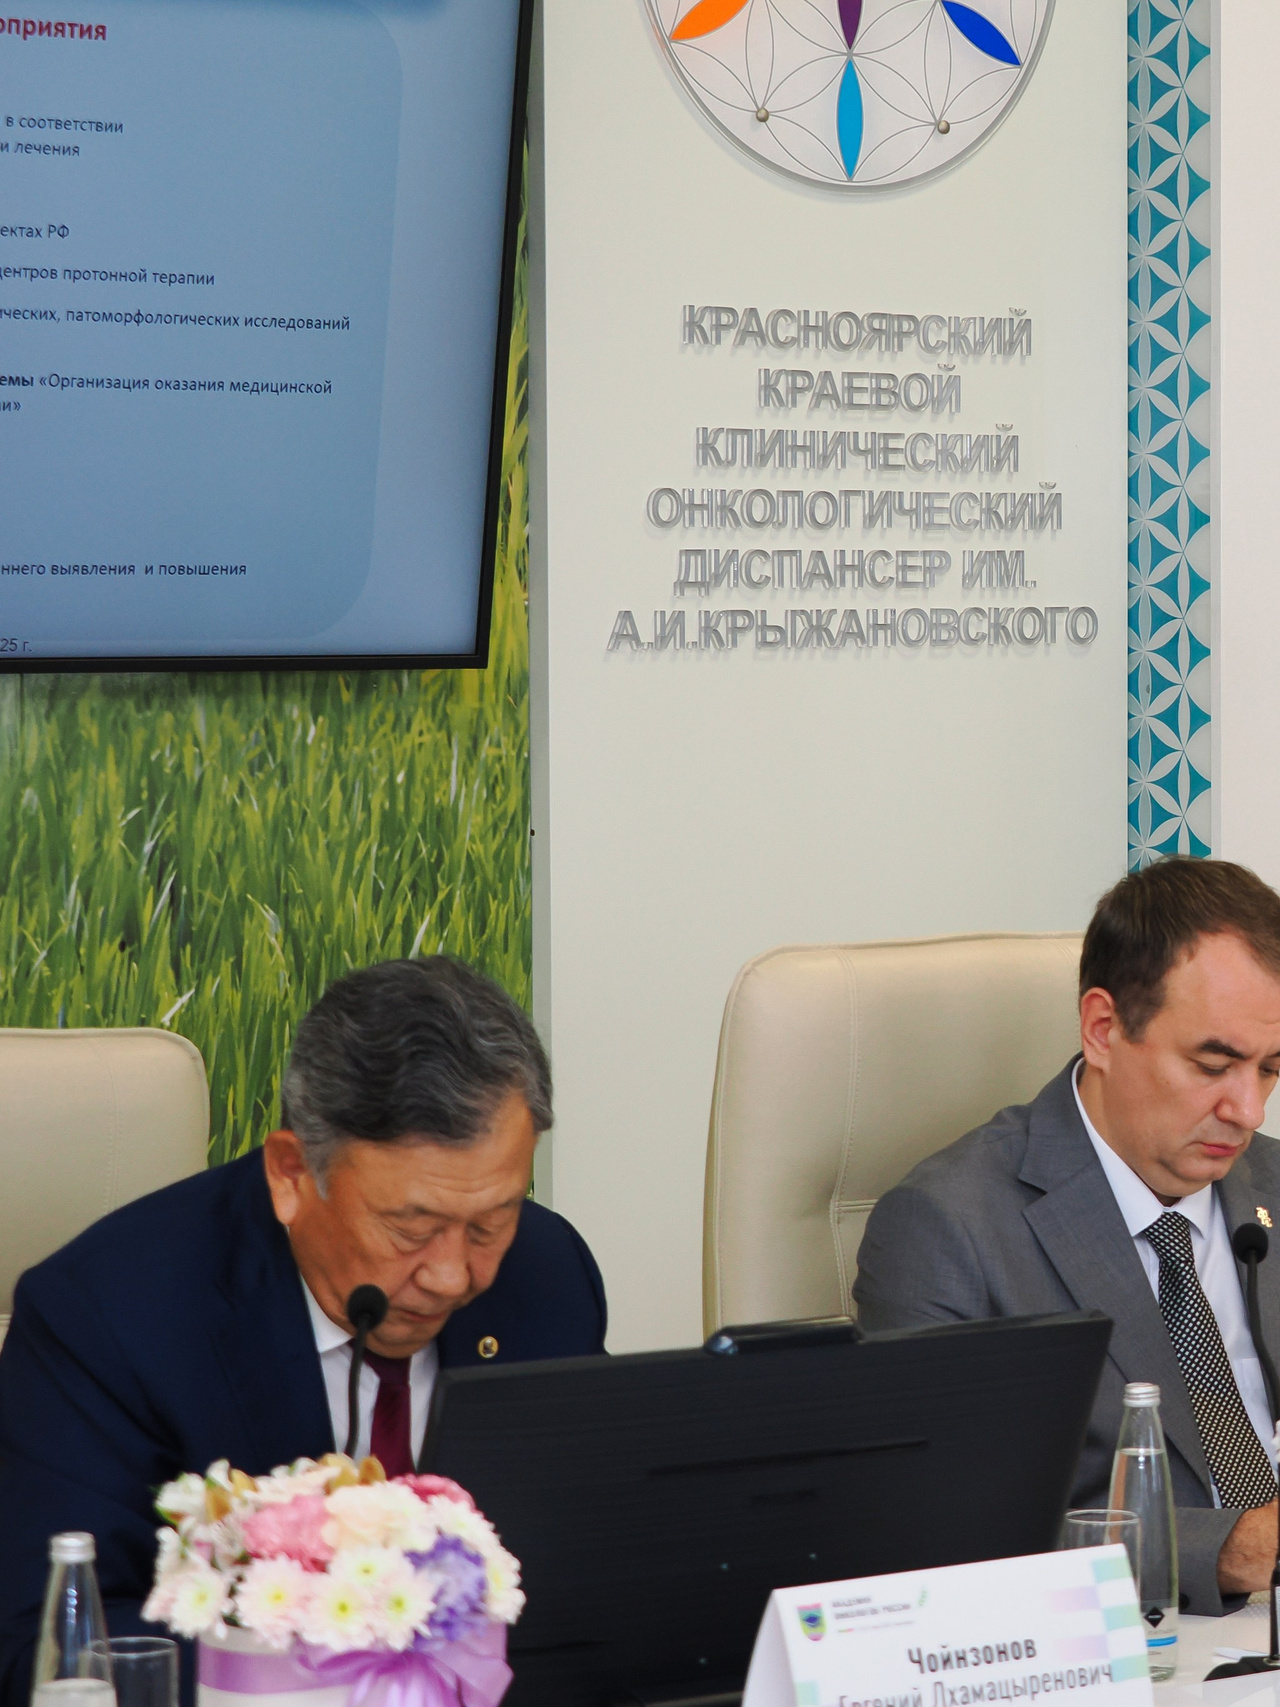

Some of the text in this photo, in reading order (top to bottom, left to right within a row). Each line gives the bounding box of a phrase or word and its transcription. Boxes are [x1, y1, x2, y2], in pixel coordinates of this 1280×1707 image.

[6, 116, 124, 134] в соответствии
[0, 141, 80, 157] и лечения
[0, 223, 70, 239] ектах РФ
[63, 268, 148, 283] протонной
[152, 271, 215, 287] терапии
[66, 309, 239, 328] патоморфологических
[244, 316, 350, 332] исследований
[682, 304, 1032, 357] КРАСНОЯРСКИЙ
[39, 373, 149, 392] «Организация
[154, 378, 225, 392] оказания
[229, 379, 332, 396] медицинской
[758, 362, 962, 414] КРАЕВОЙ
[695, 423, 1020, 473] КЛИНИЧЕСКИЙ
[646, 481, 1063, 531] ОНКОЛОГИЧЕСКИЙ
[1, 563, 247, 577] ннего выявления и повышения
[673, 549, 1037, 597] ДИСПАНСЕР ИМ.
[606, 605, 1099, 652] А.И.КРЫЖАНОВСКОГО
[0, 638, 33, 652] 25 г.
[907, 1638, 1037, 1675] Чойнзонов
[932, 1662, 1114, 1707] Лхамацыренович
